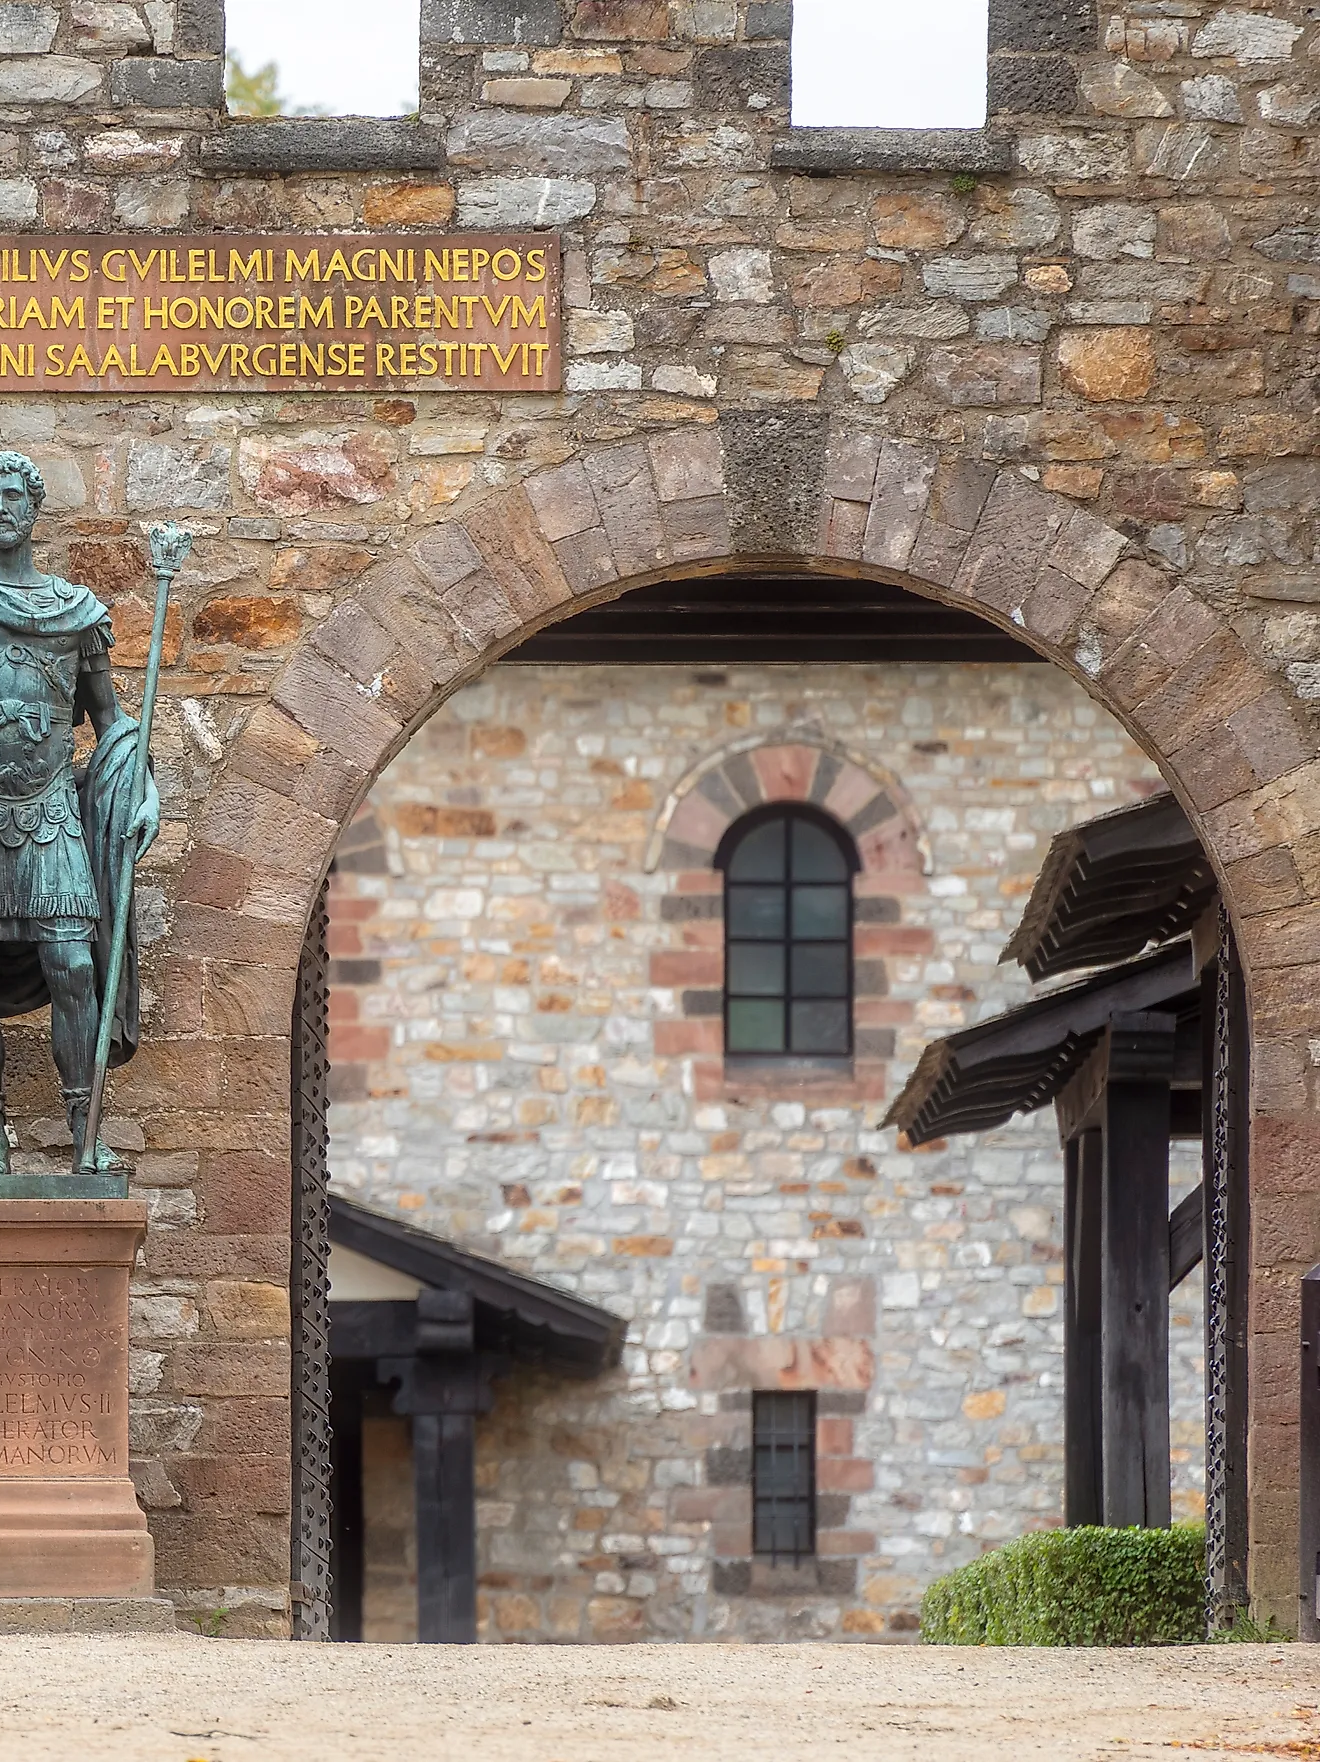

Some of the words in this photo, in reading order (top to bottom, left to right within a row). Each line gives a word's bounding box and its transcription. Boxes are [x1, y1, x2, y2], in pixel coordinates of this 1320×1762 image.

[100, 248, 275, 282] GVILELMI
[283, 248, 416, 282] MAGNI
[423, 248, 547, 282] NEPOS
[96, 294, 136, 330] ET
[143, 294, 336, 330] HONOREM
[344, 294, 548, 330] PARENTVM
[43, 342, 366, 377] SAALABVRGENSE
[375, 342, 551, 377] RESTITVIT
